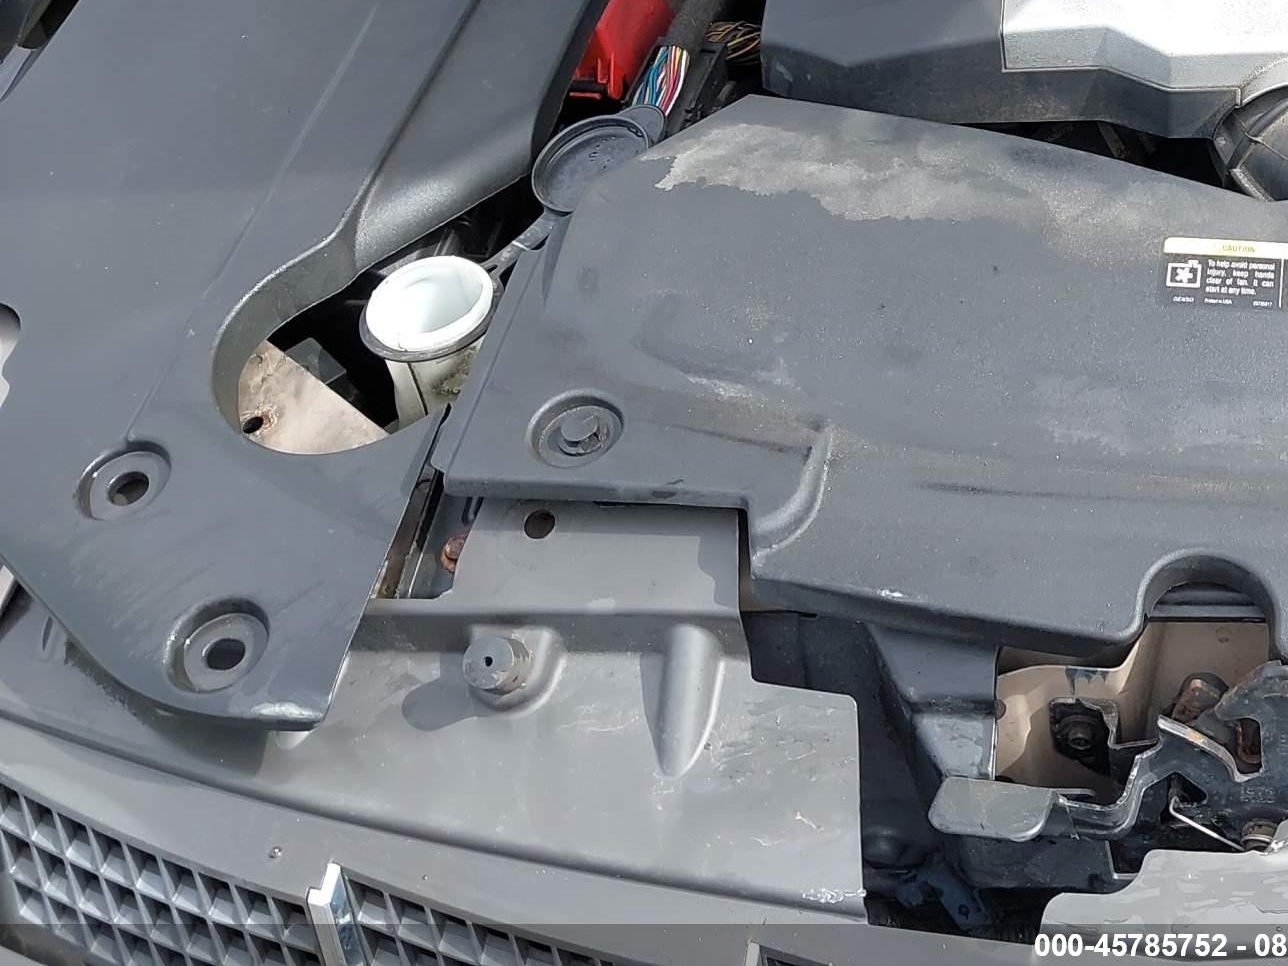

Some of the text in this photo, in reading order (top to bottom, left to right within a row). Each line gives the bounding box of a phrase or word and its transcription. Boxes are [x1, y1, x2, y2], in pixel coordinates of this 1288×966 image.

[1222, 244, 1256, 253] CAUTION
[1216, 260, 1230, 268] help
[1231, 261, 1248, 269] avoid
[1249, 262, 1275, 270] personal
[1233, 270, 1248, 278] keep
[1255, 271, 1274, 279] hands
[1228, 287, 1240, 295] any
